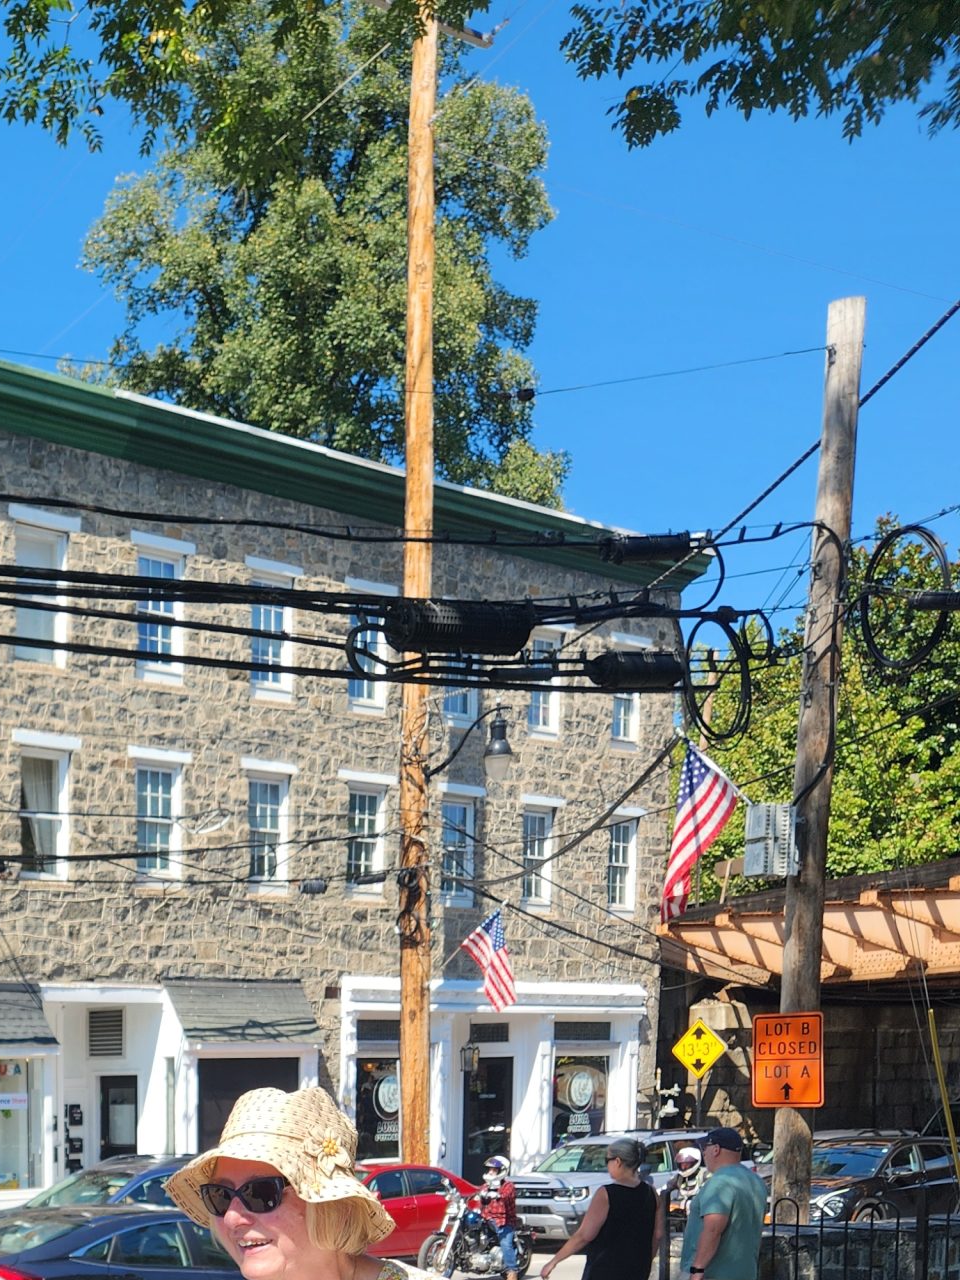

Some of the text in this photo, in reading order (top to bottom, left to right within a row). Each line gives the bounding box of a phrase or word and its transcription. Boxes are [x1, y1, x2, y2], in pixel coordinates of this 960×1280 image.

[765, 1022, 810, 1036] LOT B
[758, 1041, 817, 1055] CLOSED
[764, 1065, 810, 1079] LOT A
